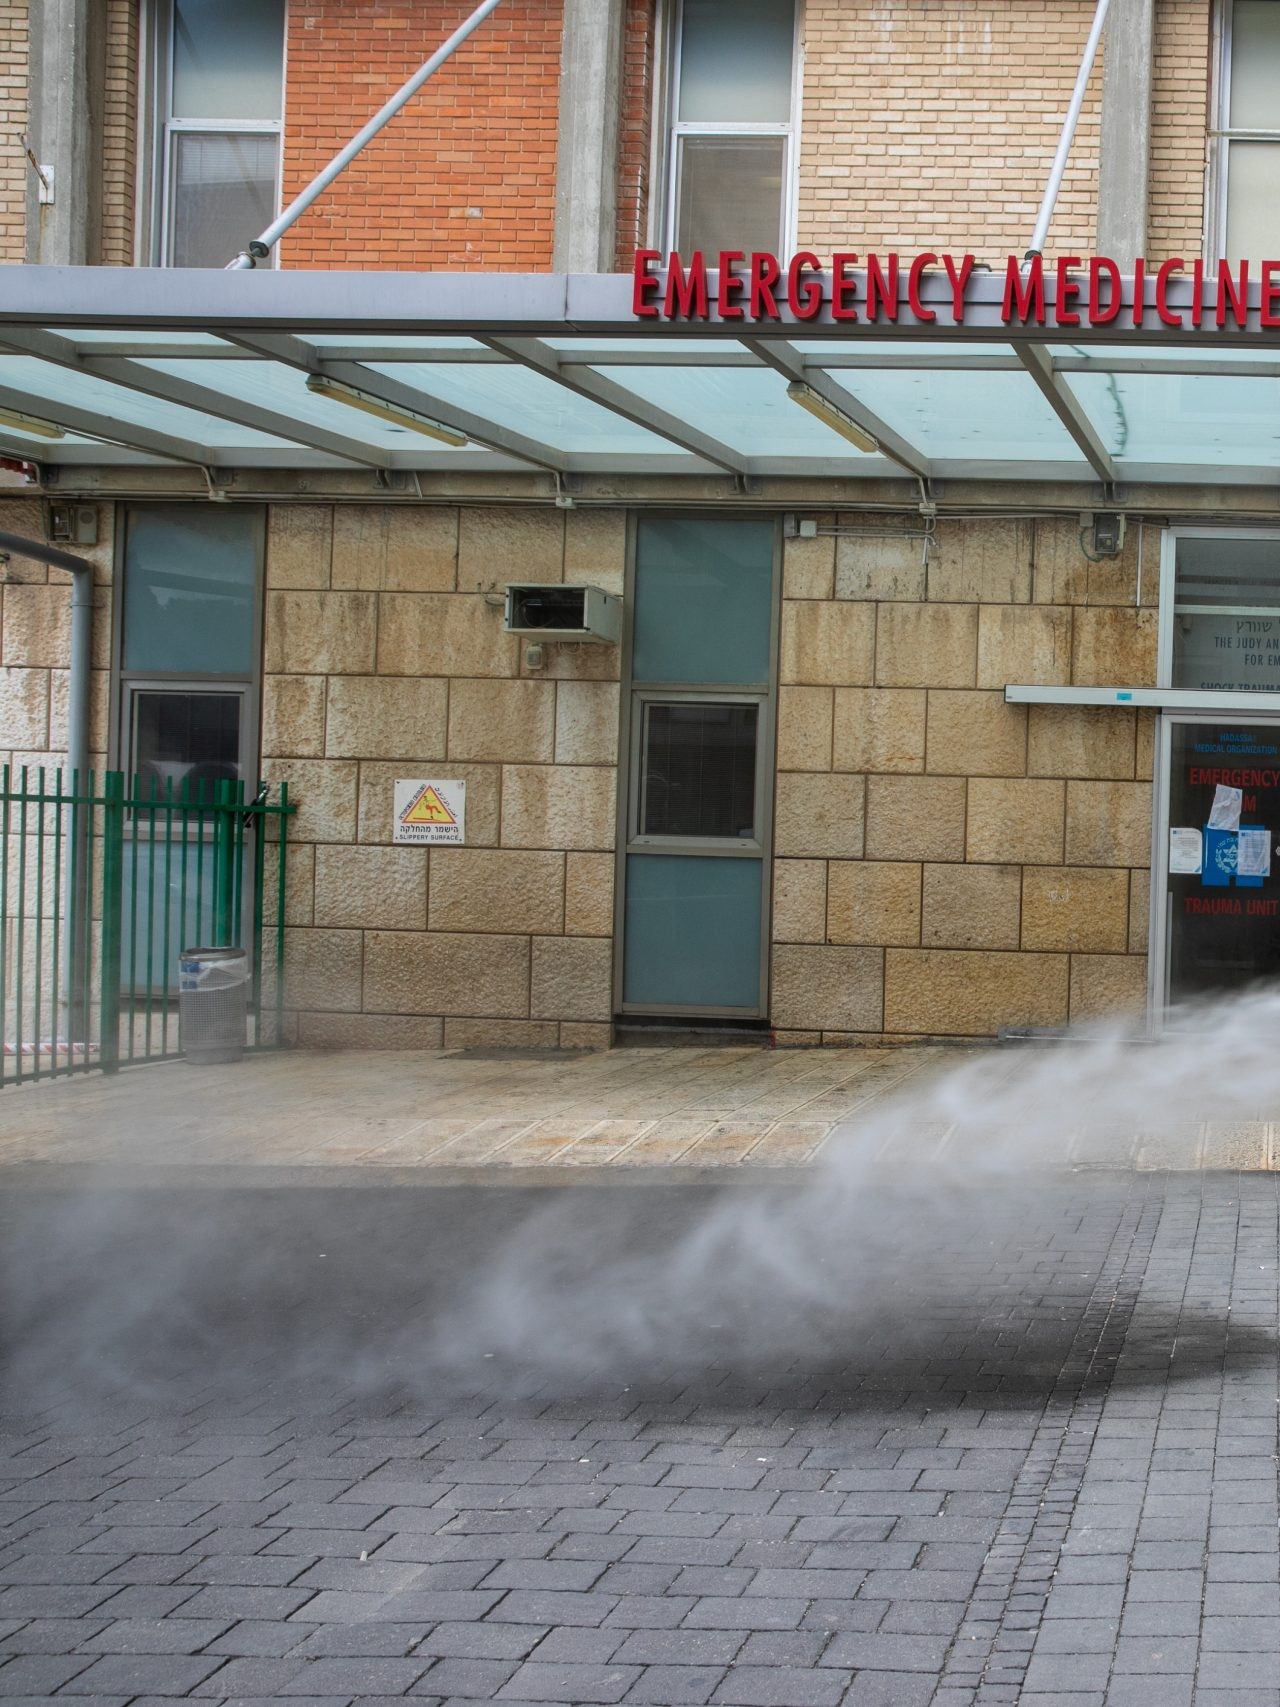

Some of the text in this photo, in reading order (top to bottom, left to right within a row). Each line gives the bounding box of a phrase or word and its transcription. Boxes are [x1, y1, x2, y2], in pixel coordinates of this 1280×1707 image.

[632, 249, 975, 321] EMERGENCY
[1236, 620, 1273, 634] שוורץ
[1214, 636, 1233, 649] THE
[1236, 637, 1262, 650] JUDY
[1244, 654, 1264, 666] FOR
[1194, 743, 1278, 755] MEDICAL ORGANIZATION
[1189, 767, 1280, 786] EMERGENCY
[400, 824, 431, 833] מהחלקה
[1184, 897, 1280, 916] TRAUMA UNIT
